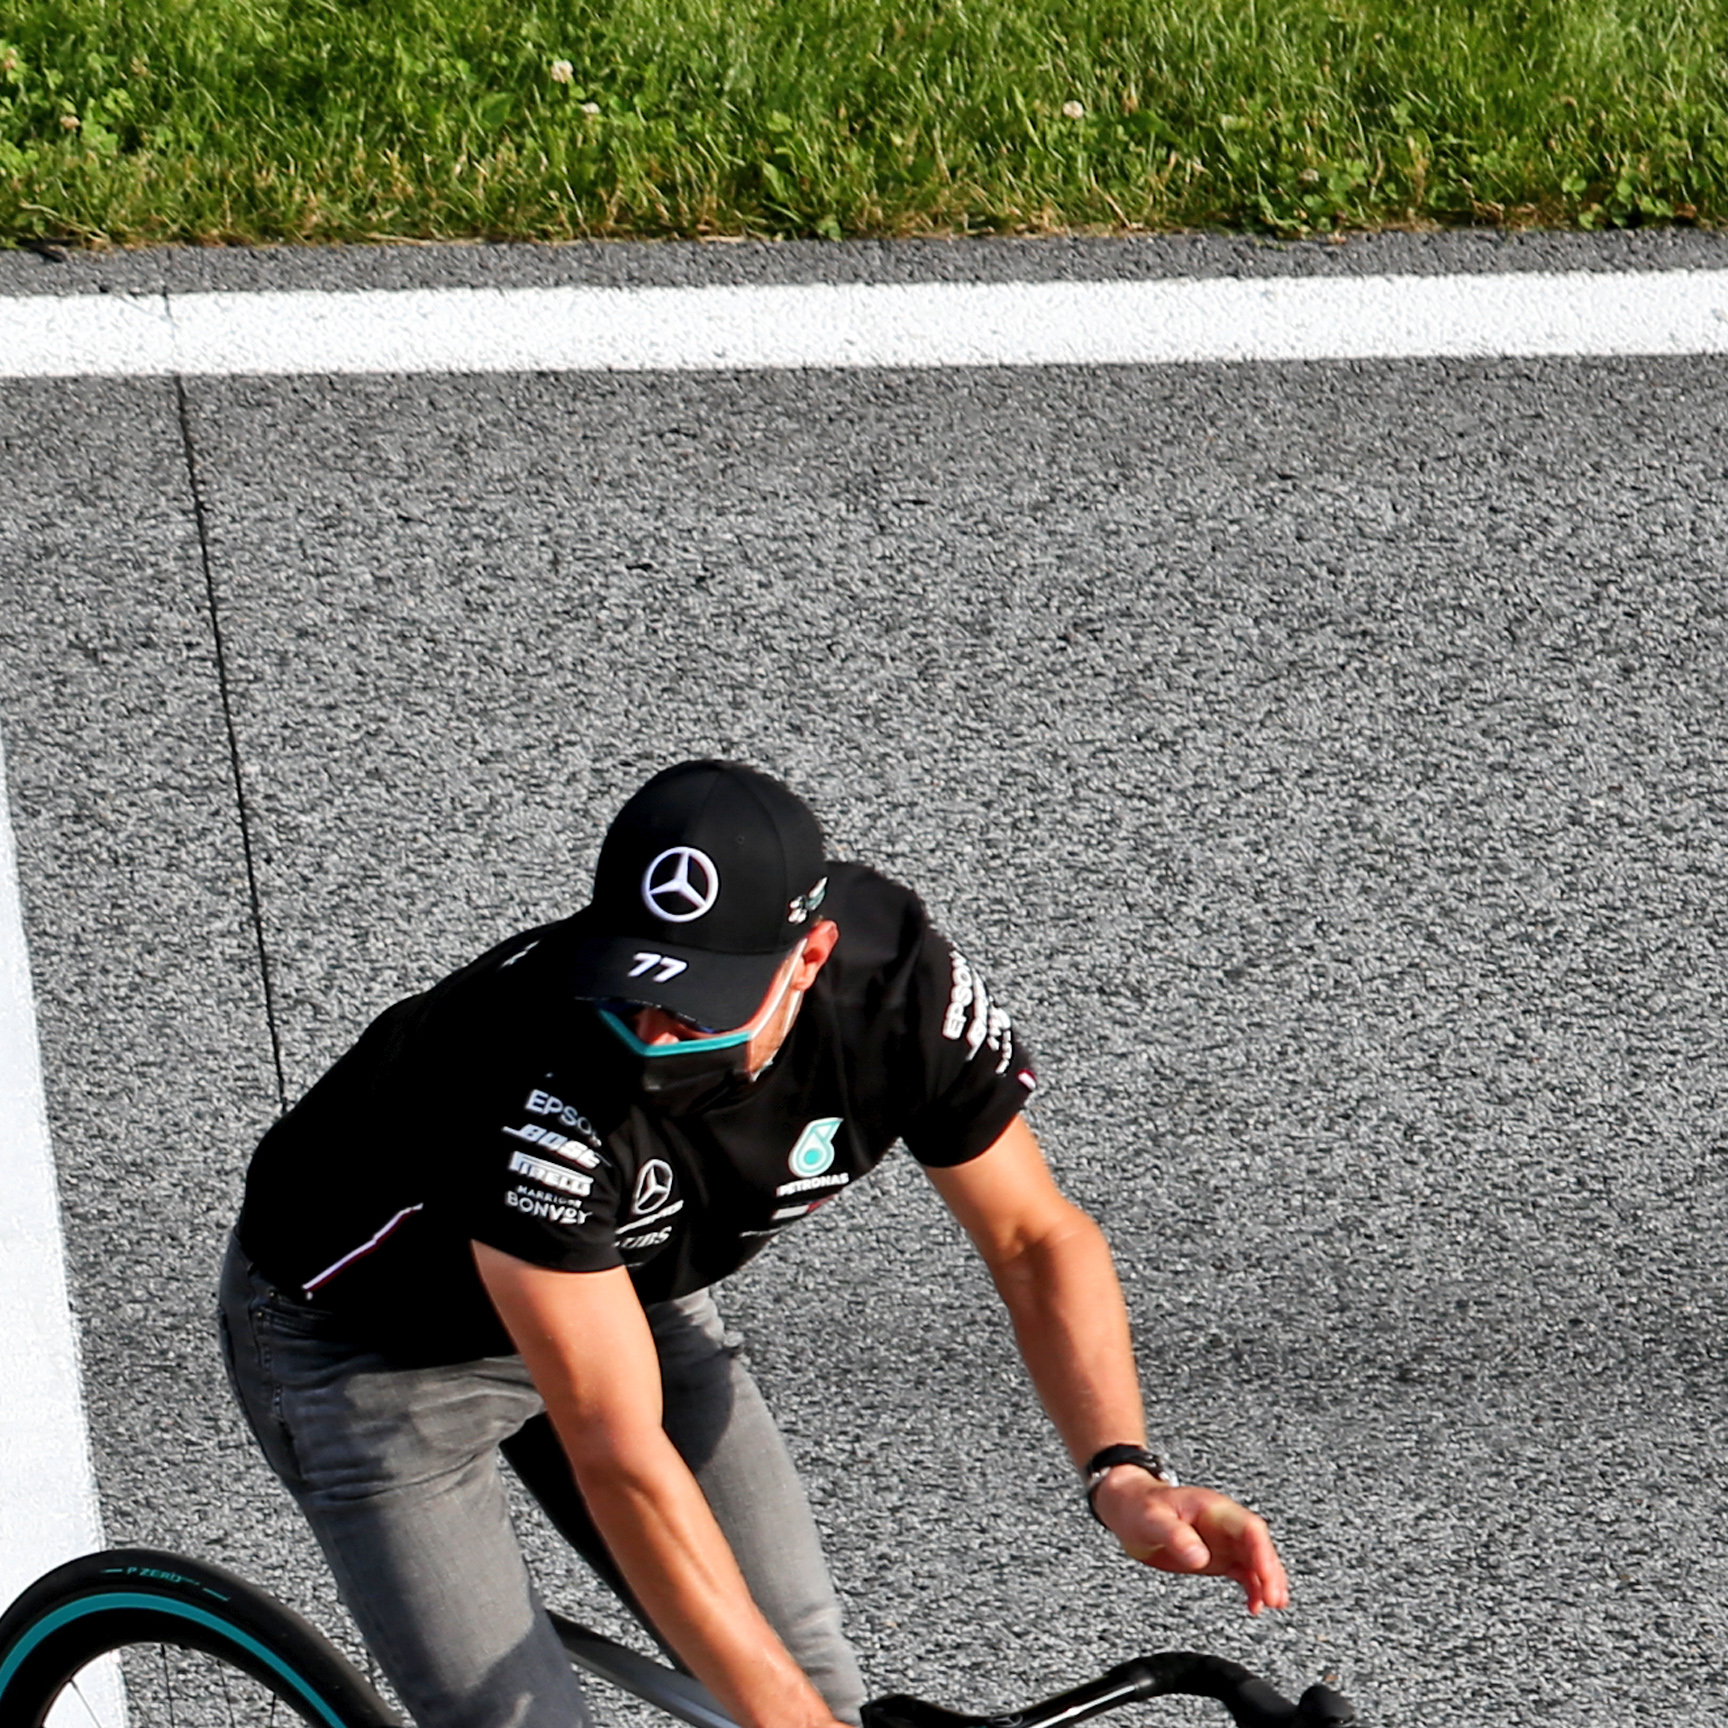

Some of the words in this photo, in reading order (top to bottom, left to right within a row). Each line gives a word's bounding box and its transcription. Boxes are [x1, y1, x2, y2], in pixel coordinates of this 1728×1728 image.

[627, 952, 688, 983] 77
[501, 1123, 611, 1169] BOSE
[776, 1172, 850, 1197] PETRONAS
[505, 1190, 592, 1225] BONVOY
